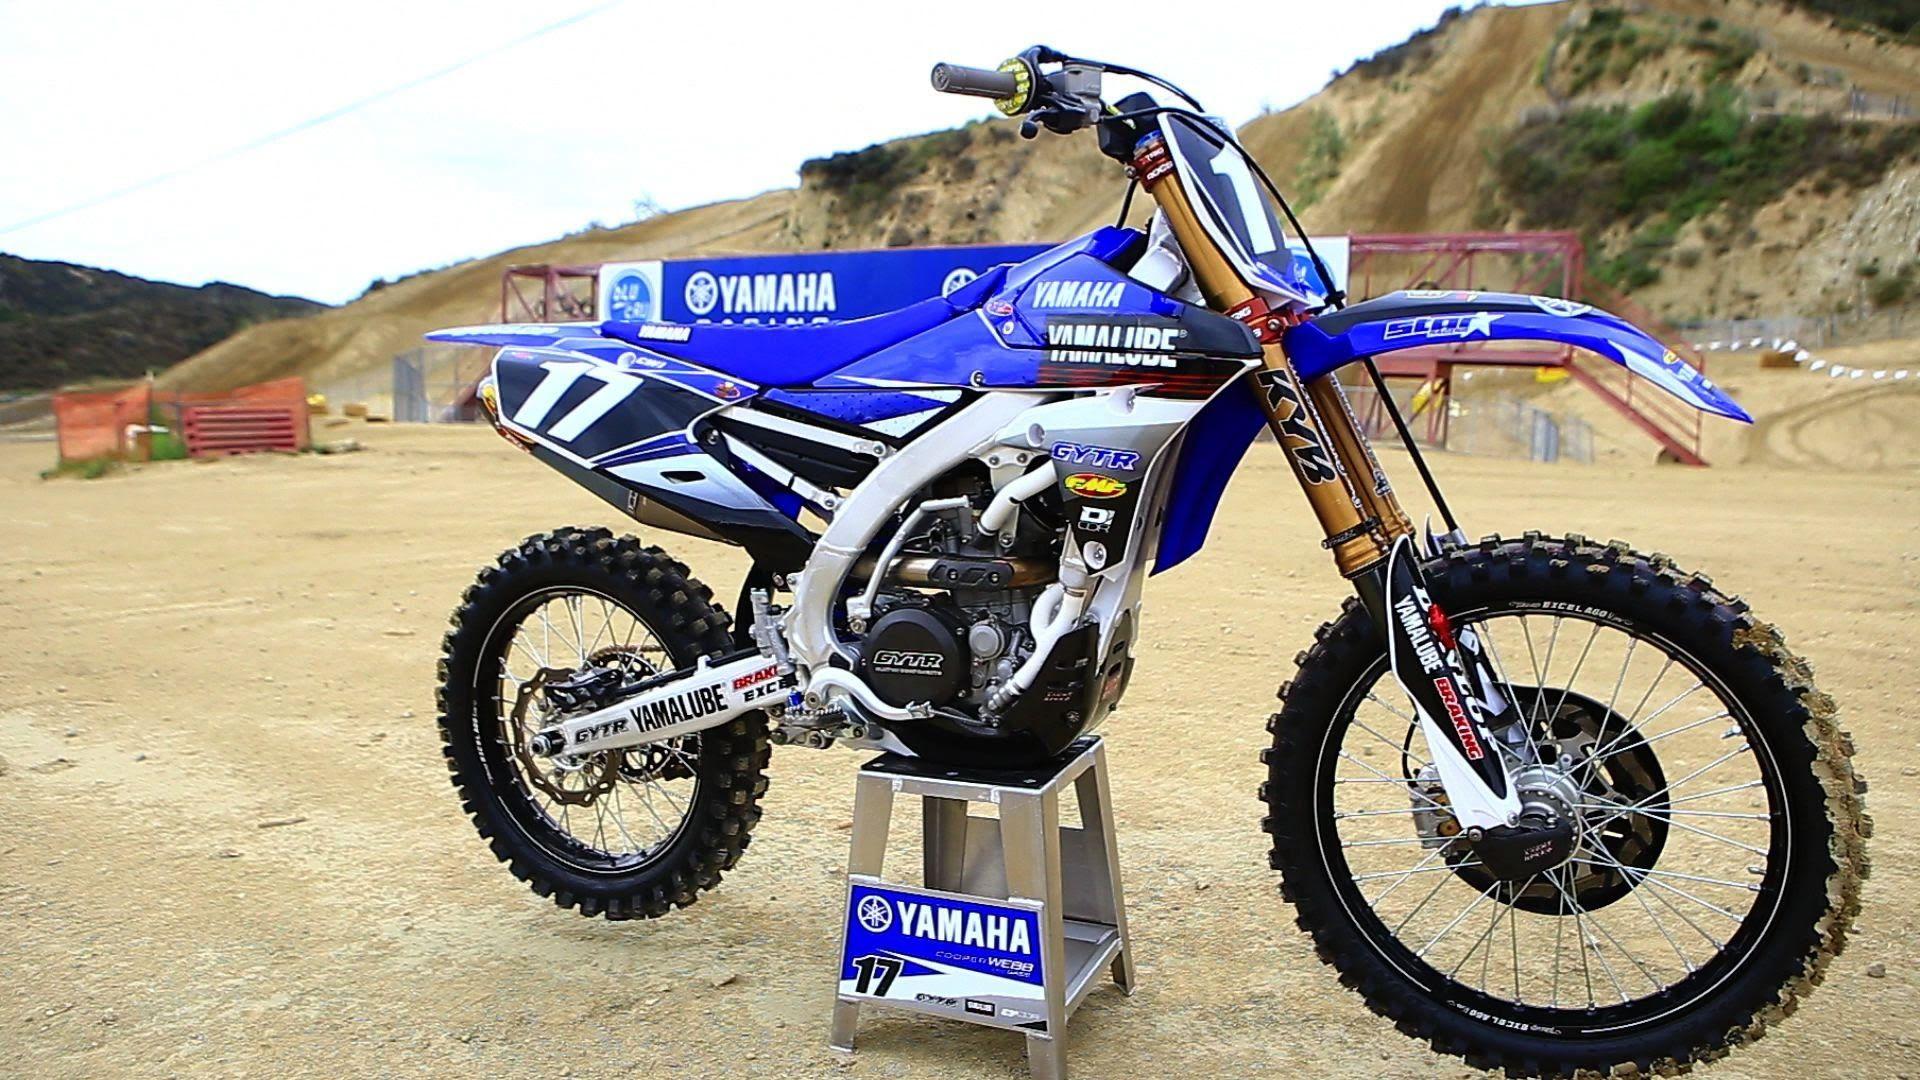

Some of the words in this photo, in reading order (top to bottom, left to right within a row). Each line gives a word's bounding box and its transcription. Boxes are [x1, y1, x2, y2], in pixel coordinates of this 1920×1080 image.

[1209, 141, 1277, 255] 1
[719, 272, 836, 313] YAMAHA
[1032, 281, 1126, 308] YAMAHA
[638, 325, 691, 343] YAMAHA
[513, 361, 644, 443] 17
[1255, 367, 1337, 486] KYB
[1052, 441, 1141, 471] GYTR
[1064, 474, 1126, 494] FMF
[1541, 601, 1582, 613] EXCEL
[731, 664, 778, 691] BRAKI
[873, 650, 944, 668] GYTR
[1394, 594, 1444, 675] YAMALUBE
[1433, 676, 1484, 761] BRAKING
[1412, 585, 1497, 751] DNLOP
[575, 717, 630, 745] GYTR
[630, 684, 729, 734] YAMALUBE
[897, 900, 1031, 955] YAMAHA
[853, 954, 904, 997] 17
[987, 956, 1035, 973] WEBB
